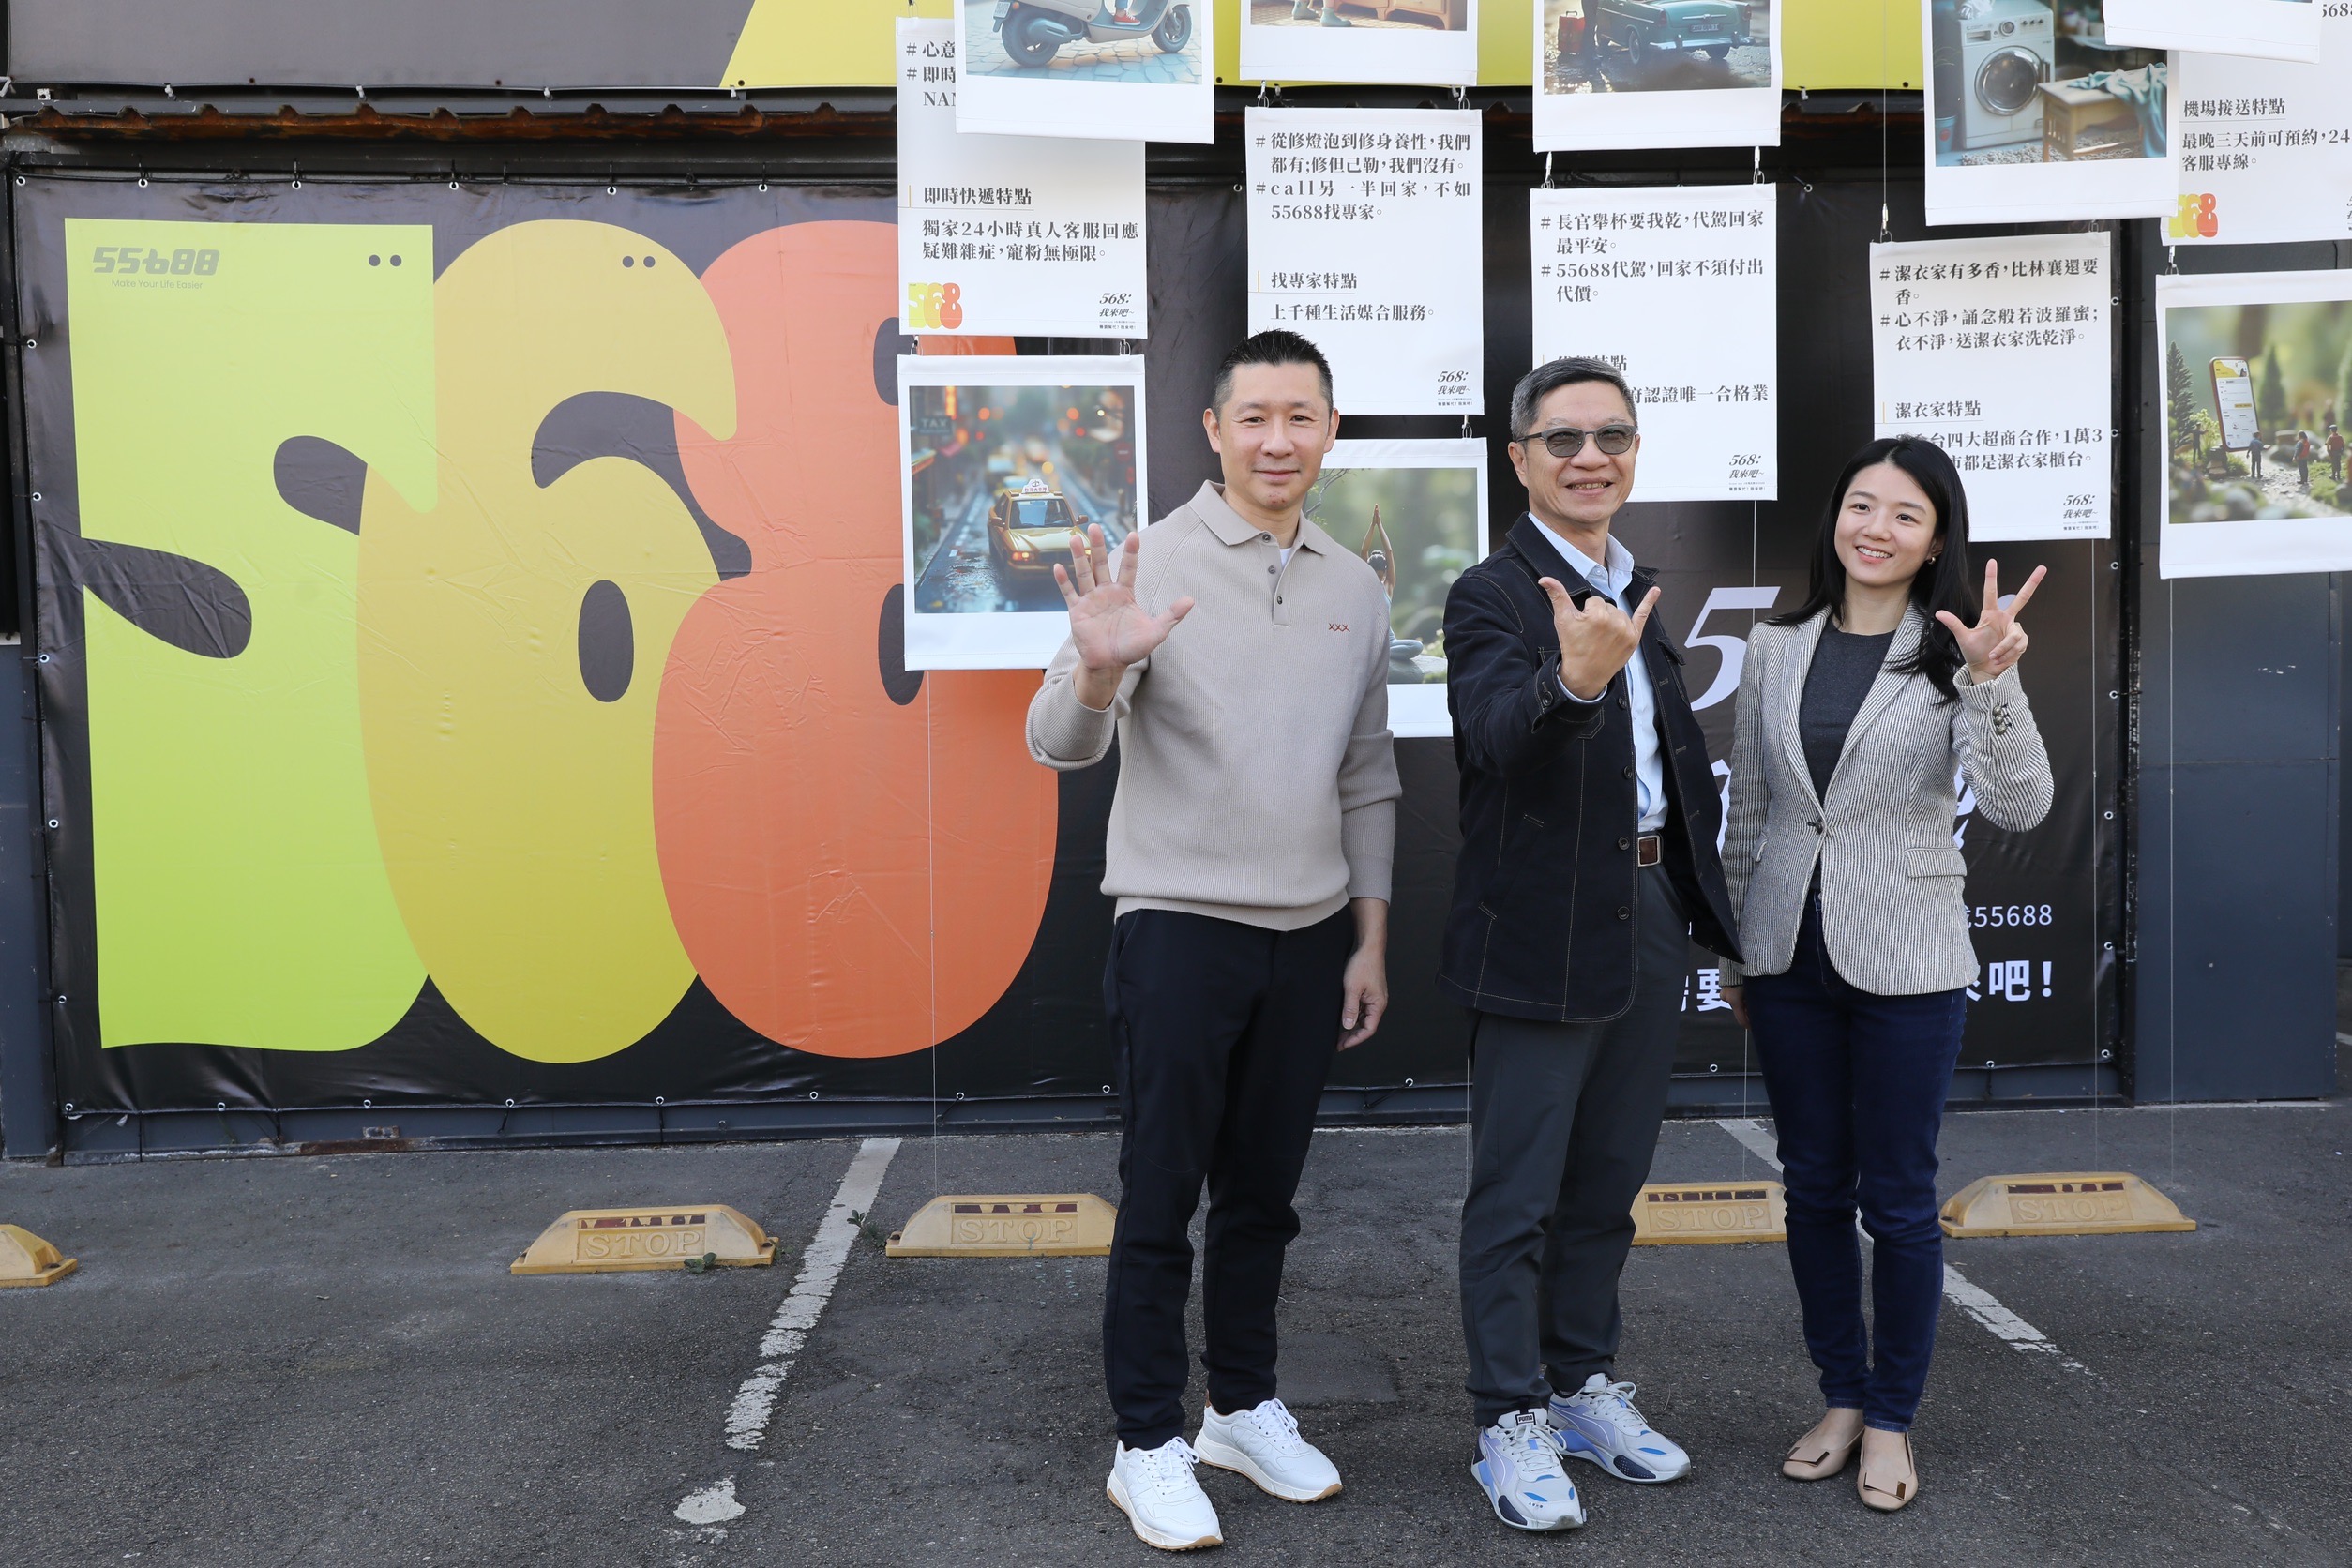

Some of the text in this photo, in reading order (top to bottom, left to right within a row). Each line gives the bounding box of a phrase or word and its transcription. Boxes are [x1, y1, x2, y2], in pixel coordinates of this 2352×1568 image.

[2183, 98, 2286, 118] 機場接送特點
[2181, 153, 2257, 172] 客服專線。
[924, 187, 1033, 205] 即時快遞特點
[1271, 203, 1382, 221] 55688找專家。
[922, 219, 1139, 240] 獨家24小時真人客服回應
[922, 241, 1106, 263] 疑難雜症,寵粉無極限。
[1556, 236, 1617, 255] 最平安。
[93, 246, 220, 276] 55688
[112, 279, 204, 290] Make Your Life Easier
[1271, 271, 1358, 290] 找專家特點
[1556, 284, 1599, 303] 代價。
[1895, 288, 1920, 306] 香。
[908, 281, 963, 329] 568
[1271, 303, 1434, 322] 上千種生活媒合服務。
[1895, 400, 1982, 419] 潔衣家特點
[1656, 1205, 1765, 1231] STOP
[2016, 1197, 2125, 1222] STOP
[958, 1217, 1074, 1244] STOP
[584, 1230, 701, 1259] STOP
